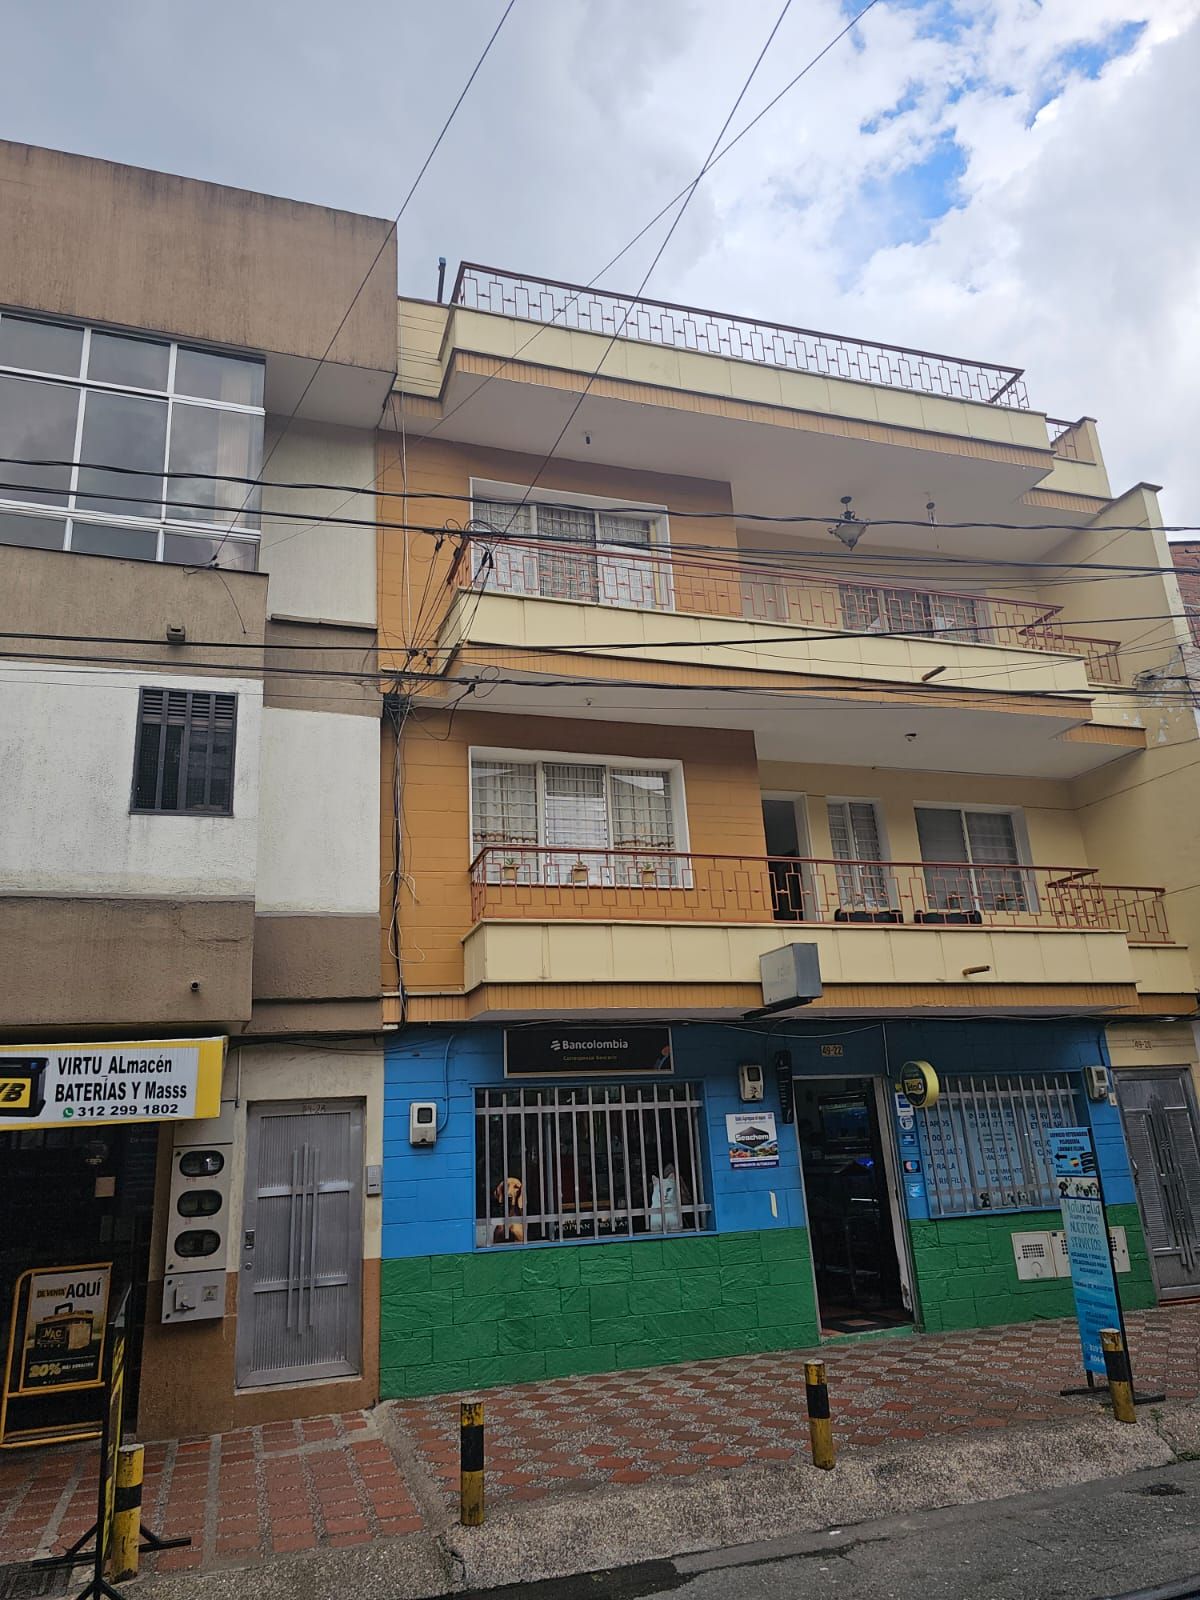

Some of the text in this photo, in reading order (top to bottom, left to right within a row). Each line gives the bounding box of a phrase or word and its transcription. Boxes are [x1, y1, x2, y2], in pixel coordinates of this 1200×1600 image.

[562, 1039, 629, 1050] Bancolombia
[55, 1078, 187, 1103] BATERÍAS Y Masss
[78, 1104, 178, 1117] 312 299 1802
[736, 1134, 769, 1142] Seachem
[37, 1289, 46, 1299] DE
[66, 1276, 102, 1299] AQUÍ
